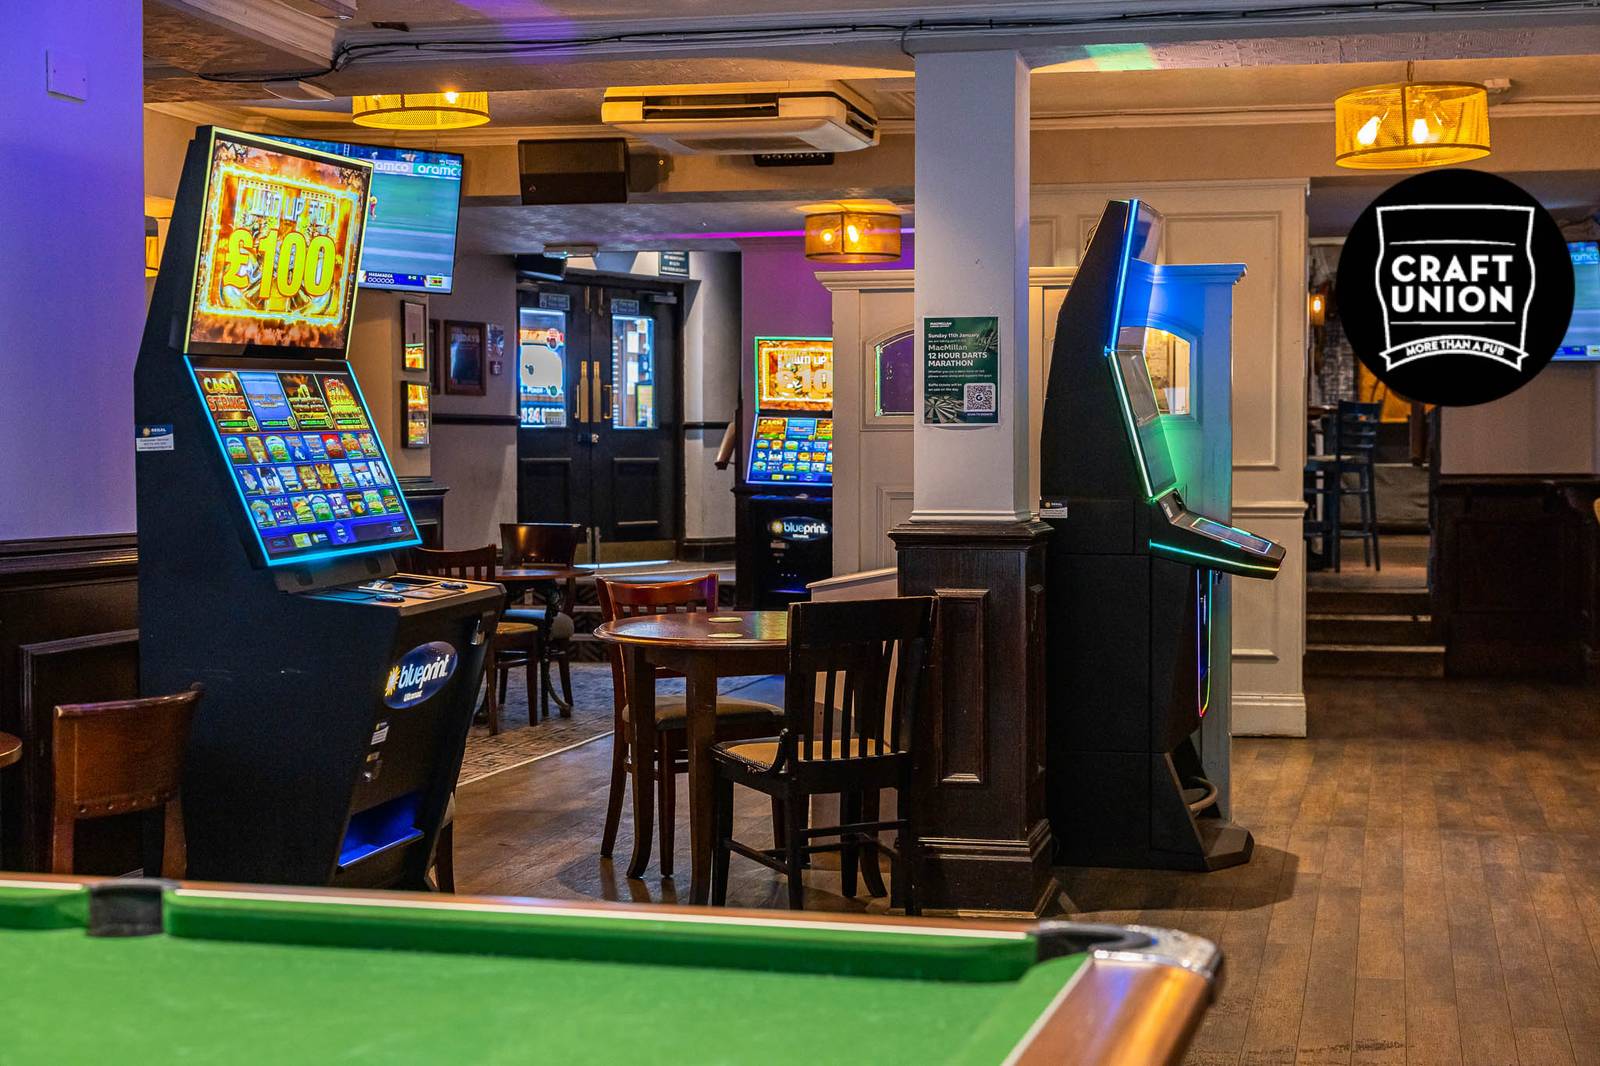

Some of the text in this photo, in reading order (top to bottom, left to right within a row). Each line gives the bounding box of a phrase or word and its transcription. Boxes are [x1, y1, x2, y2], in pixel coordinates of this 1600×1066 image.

[374, 161, 409, 172] amco
[223, 228, 336, 299] £100
[928, 352, 937, 360] 12
[962, 351, 988, 359] DARTS
[203, 377, 239, 394] CASH
